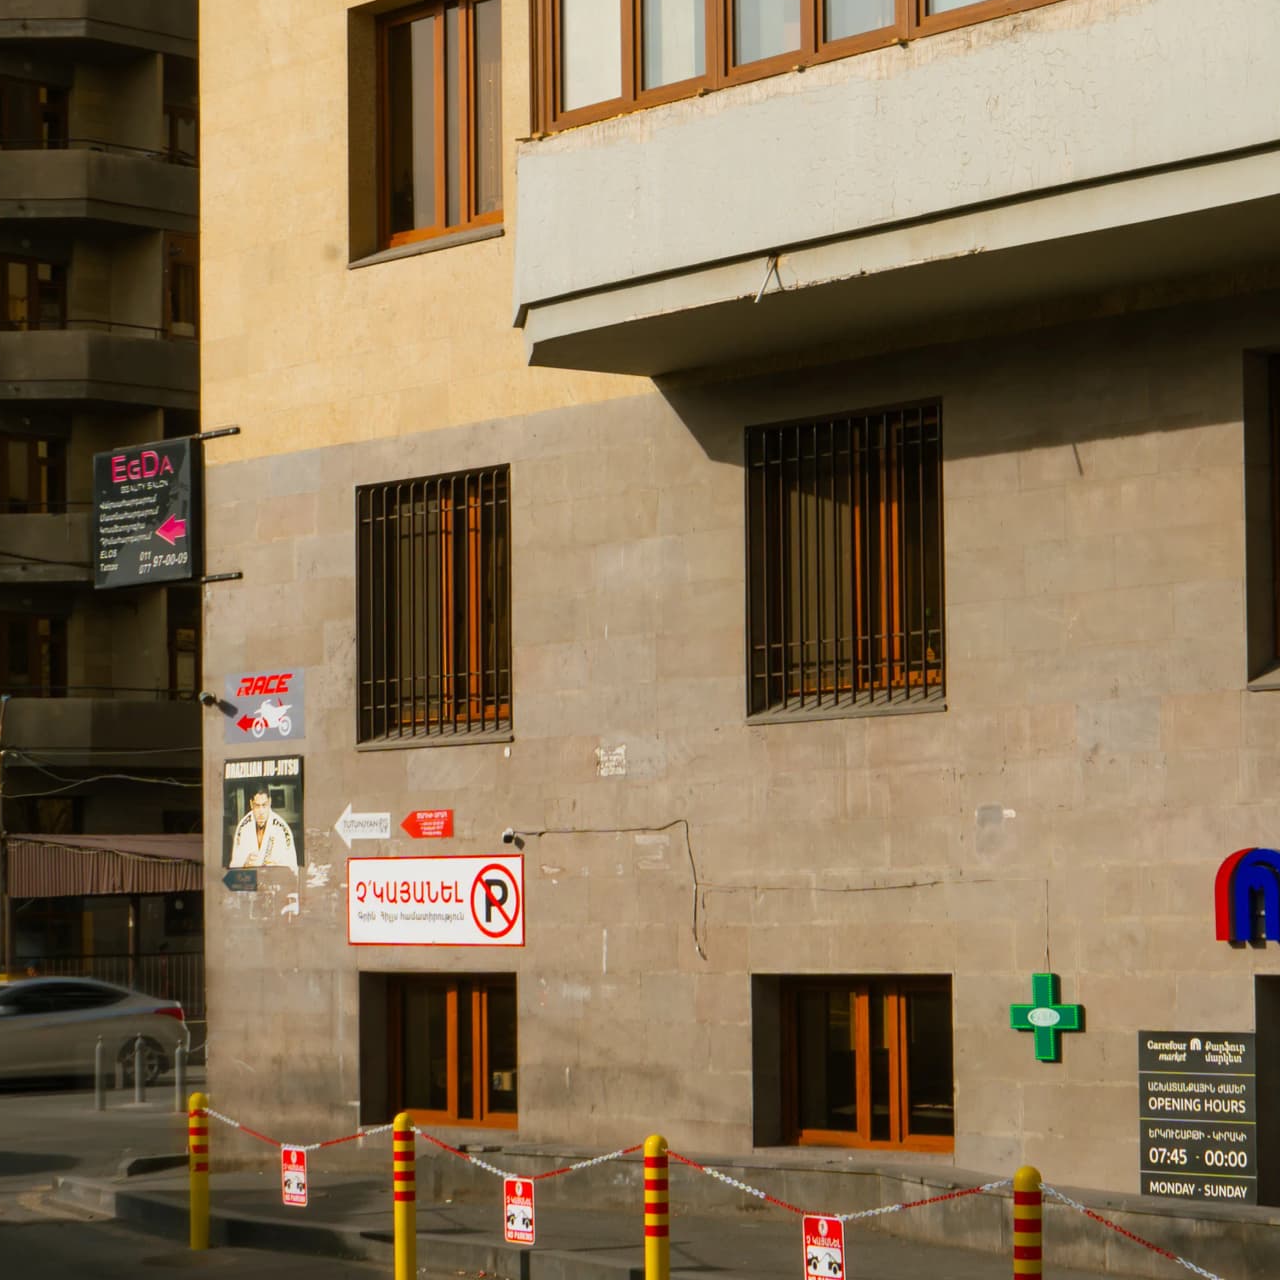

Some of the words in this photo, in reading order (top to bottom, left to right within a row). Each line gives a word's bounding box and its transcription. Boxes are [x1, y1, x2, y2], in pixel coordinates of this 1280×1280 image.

[139, 551, 151, 561] 011
[153, 552, 188, 568] 97-00-09
[138, 564, 151, 575] 077
[237, 673, 292, 697] RACE
[225, 761, 262, 780] BRAZILIAN
[263, 758, 299, 777] JIU-JITSU
[1147, 1040, 1186, 1051] Carrefour
[1205, 1040, 1246, 1055] Քարֆուր
[1158, 1051, 1186, 1063] market
[1147, 1081, 1216, 1094] ԱՇԽԱՏԱՆՔԱՅԻՆ
[1217, 1083, 1246, 1094] ԺԱՄԵՐ
[1148, 1097, 1201, 1112] OPENING
[1204, 1099, 1246, 1113] HOURS
[1212, 1130, 1247, 1142] ԿԻՐԱԿԻ
[1149, 1147, 1188, 1165] 07:45
[1204, 1150, 1248, 1168] 00:00
[1149, 1181, 1195, 1195] MONDAY
[1204, 1184, 1248, 1199] SUNDAY
